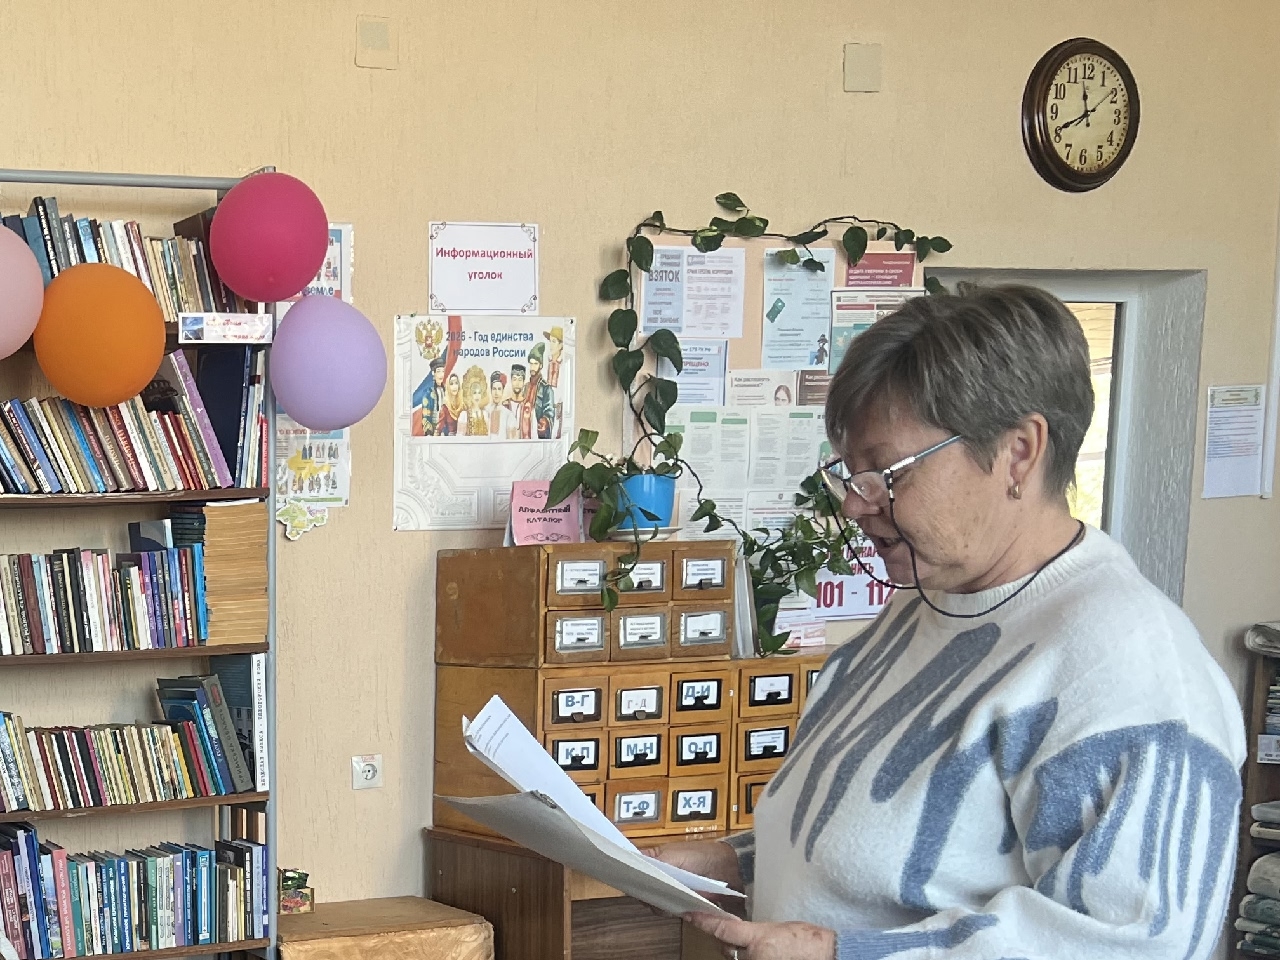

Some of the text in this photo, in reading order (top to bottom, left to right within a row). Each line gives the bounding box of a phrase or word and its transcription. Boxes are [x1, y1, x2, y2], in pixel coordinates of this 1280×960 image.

[1067, 67, 1079, 84] 11
[1082, 63, 1095, 80] 12
[1100, 71, 1106, 87] 1
[1053, 83, 1065, 100] 10
[1110, 88, 1118, 104] 2
[1050, 103, 1058, 121] 9
[1114, 109, 1121, 125] 3
[1054, 126, 1062, 143] 8
[1107, 130, 1114, 146] 4
[1065, 143, 1072, 160] 7
[1080, 149, 1087, 165] 6
[1097, 145, 1103, 161] 5
[436, 247, 533, 260] Информационный
[468, 271, 503, 281] уголок
[648, 270, 680, 282] ВЗЯТОК
[474, 331, 488, 342] Год
[490, 332, 534, 342] единства
[453, 347, 526, 359] народов России
[816, 581, 844, 608] 101
[565, 694, 590, 708] В-Г
[682, 796, 707, 808] Х-Я
